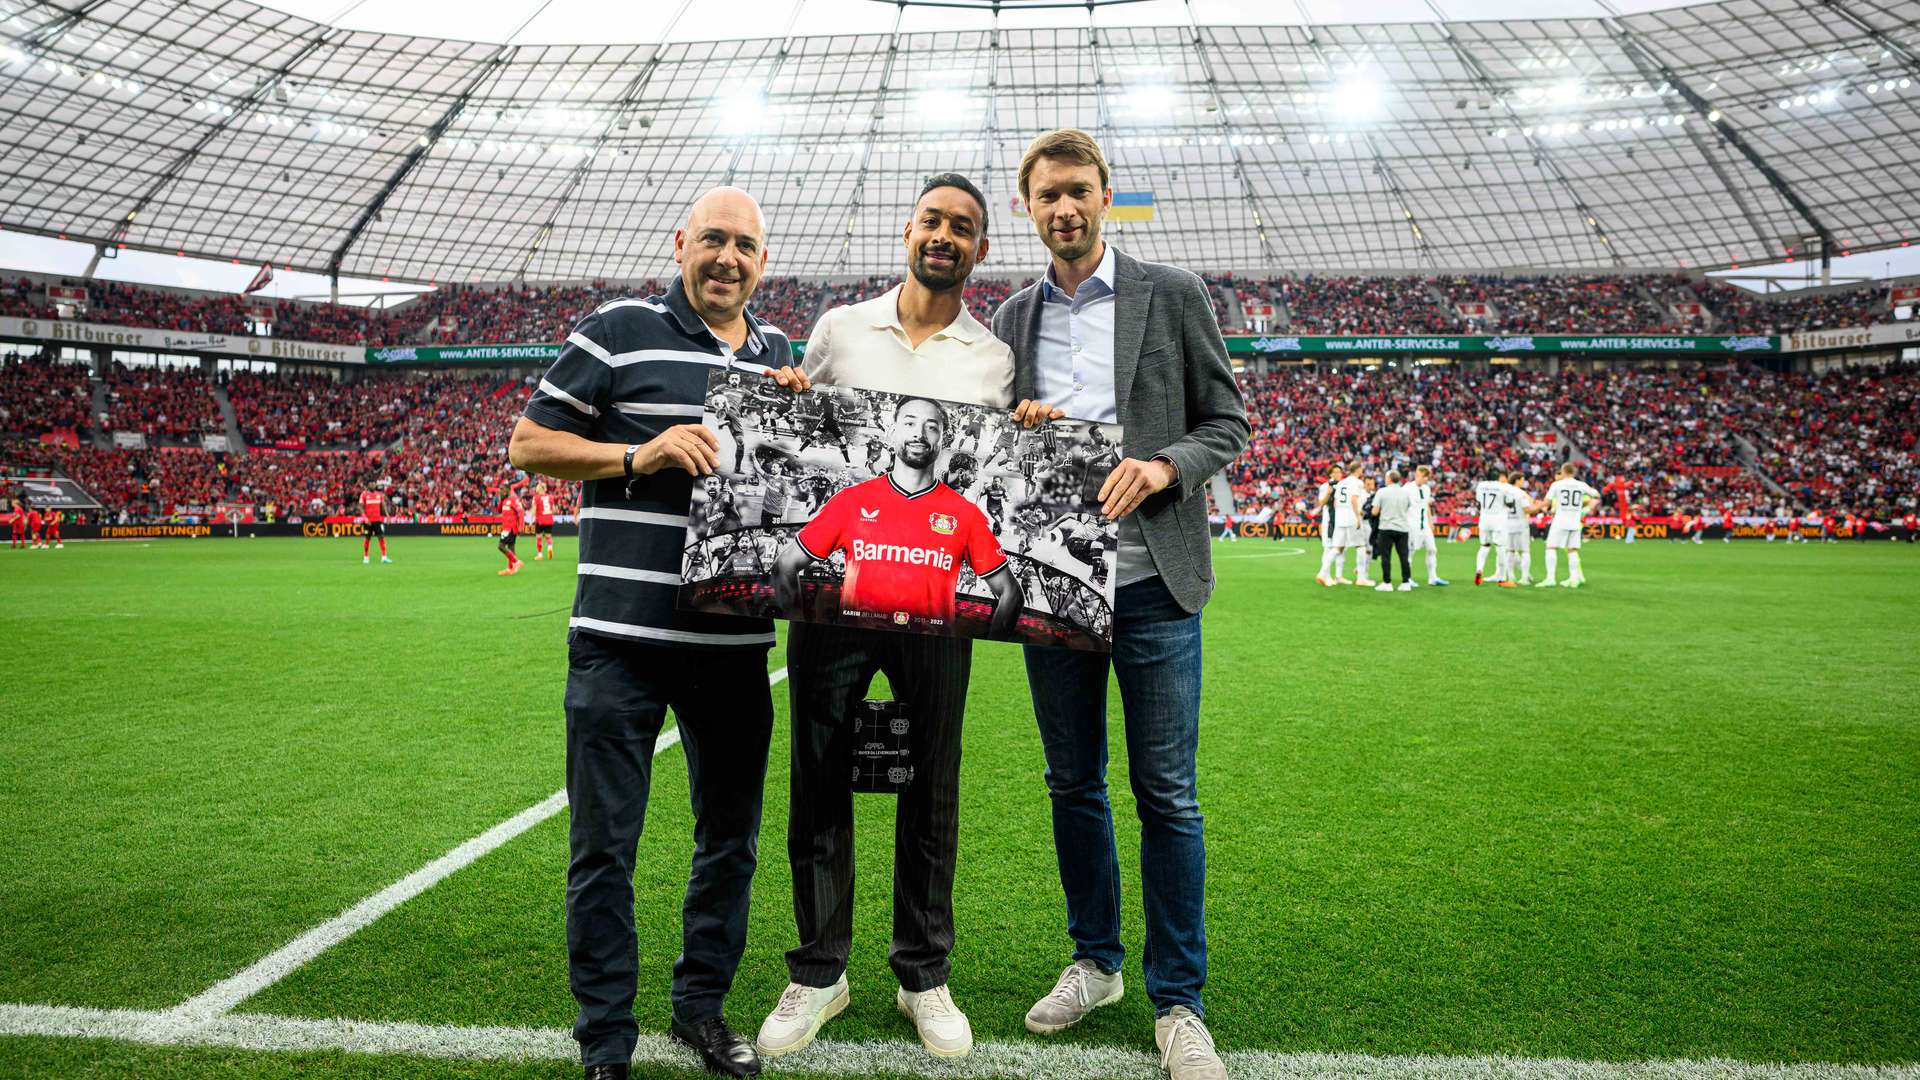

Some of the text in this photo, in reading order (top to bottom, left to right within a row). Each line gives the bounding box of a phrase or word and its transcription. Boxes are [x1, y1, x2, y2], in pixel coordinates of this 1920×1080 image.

[53, 321, 144, 345] Bitburger
[1791, 332, 1872, 349] Bitburger
[271, 341, 347, 362] Bitburger
[1340, 486, 1347, 503] 5
[1482, 492, 1497, 509] 17
[1560, 490, 1582, 507] 30
[101, 526, 211, 537] IT DIENSTLEISTUNGEN
[441, 523, 489, 535] MANAGED
[852, 539, 953, 571] Barmenia
[842, 609, 861, 617] KARIM
